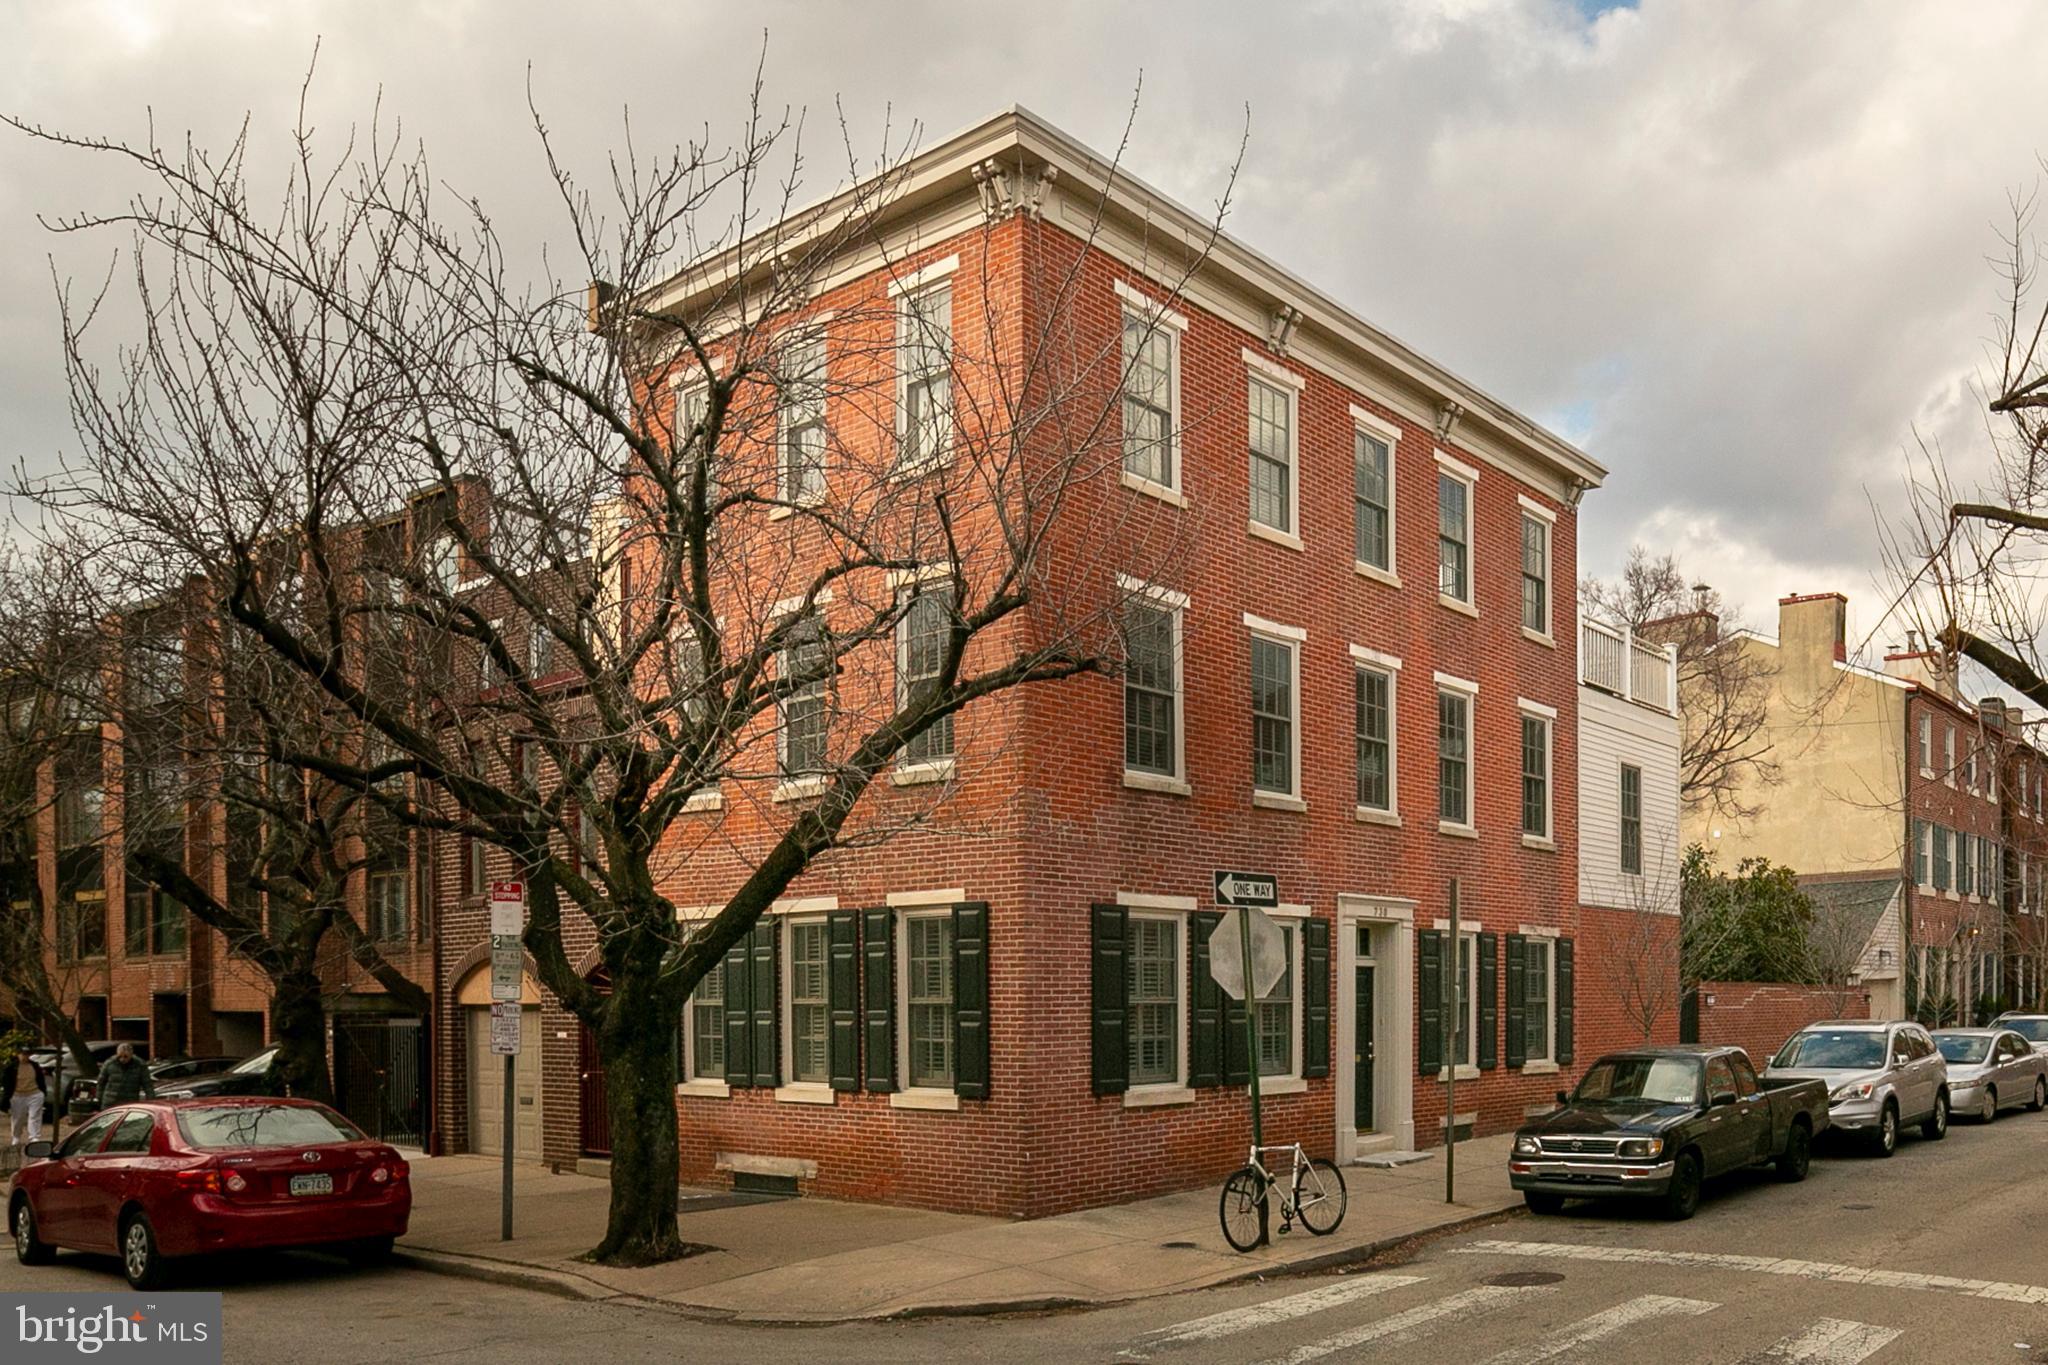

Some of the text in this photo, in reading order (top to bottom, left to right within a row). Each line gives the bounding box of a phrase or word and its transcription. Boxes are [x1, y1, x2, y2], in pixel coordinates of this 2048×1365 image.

[1233, 882, 1271, 897] ONE WAY
[494, 892, 521, 900] STOPPING
[493, 935, 501, 948] 2
[491, 1004, 503, 1016] NO
